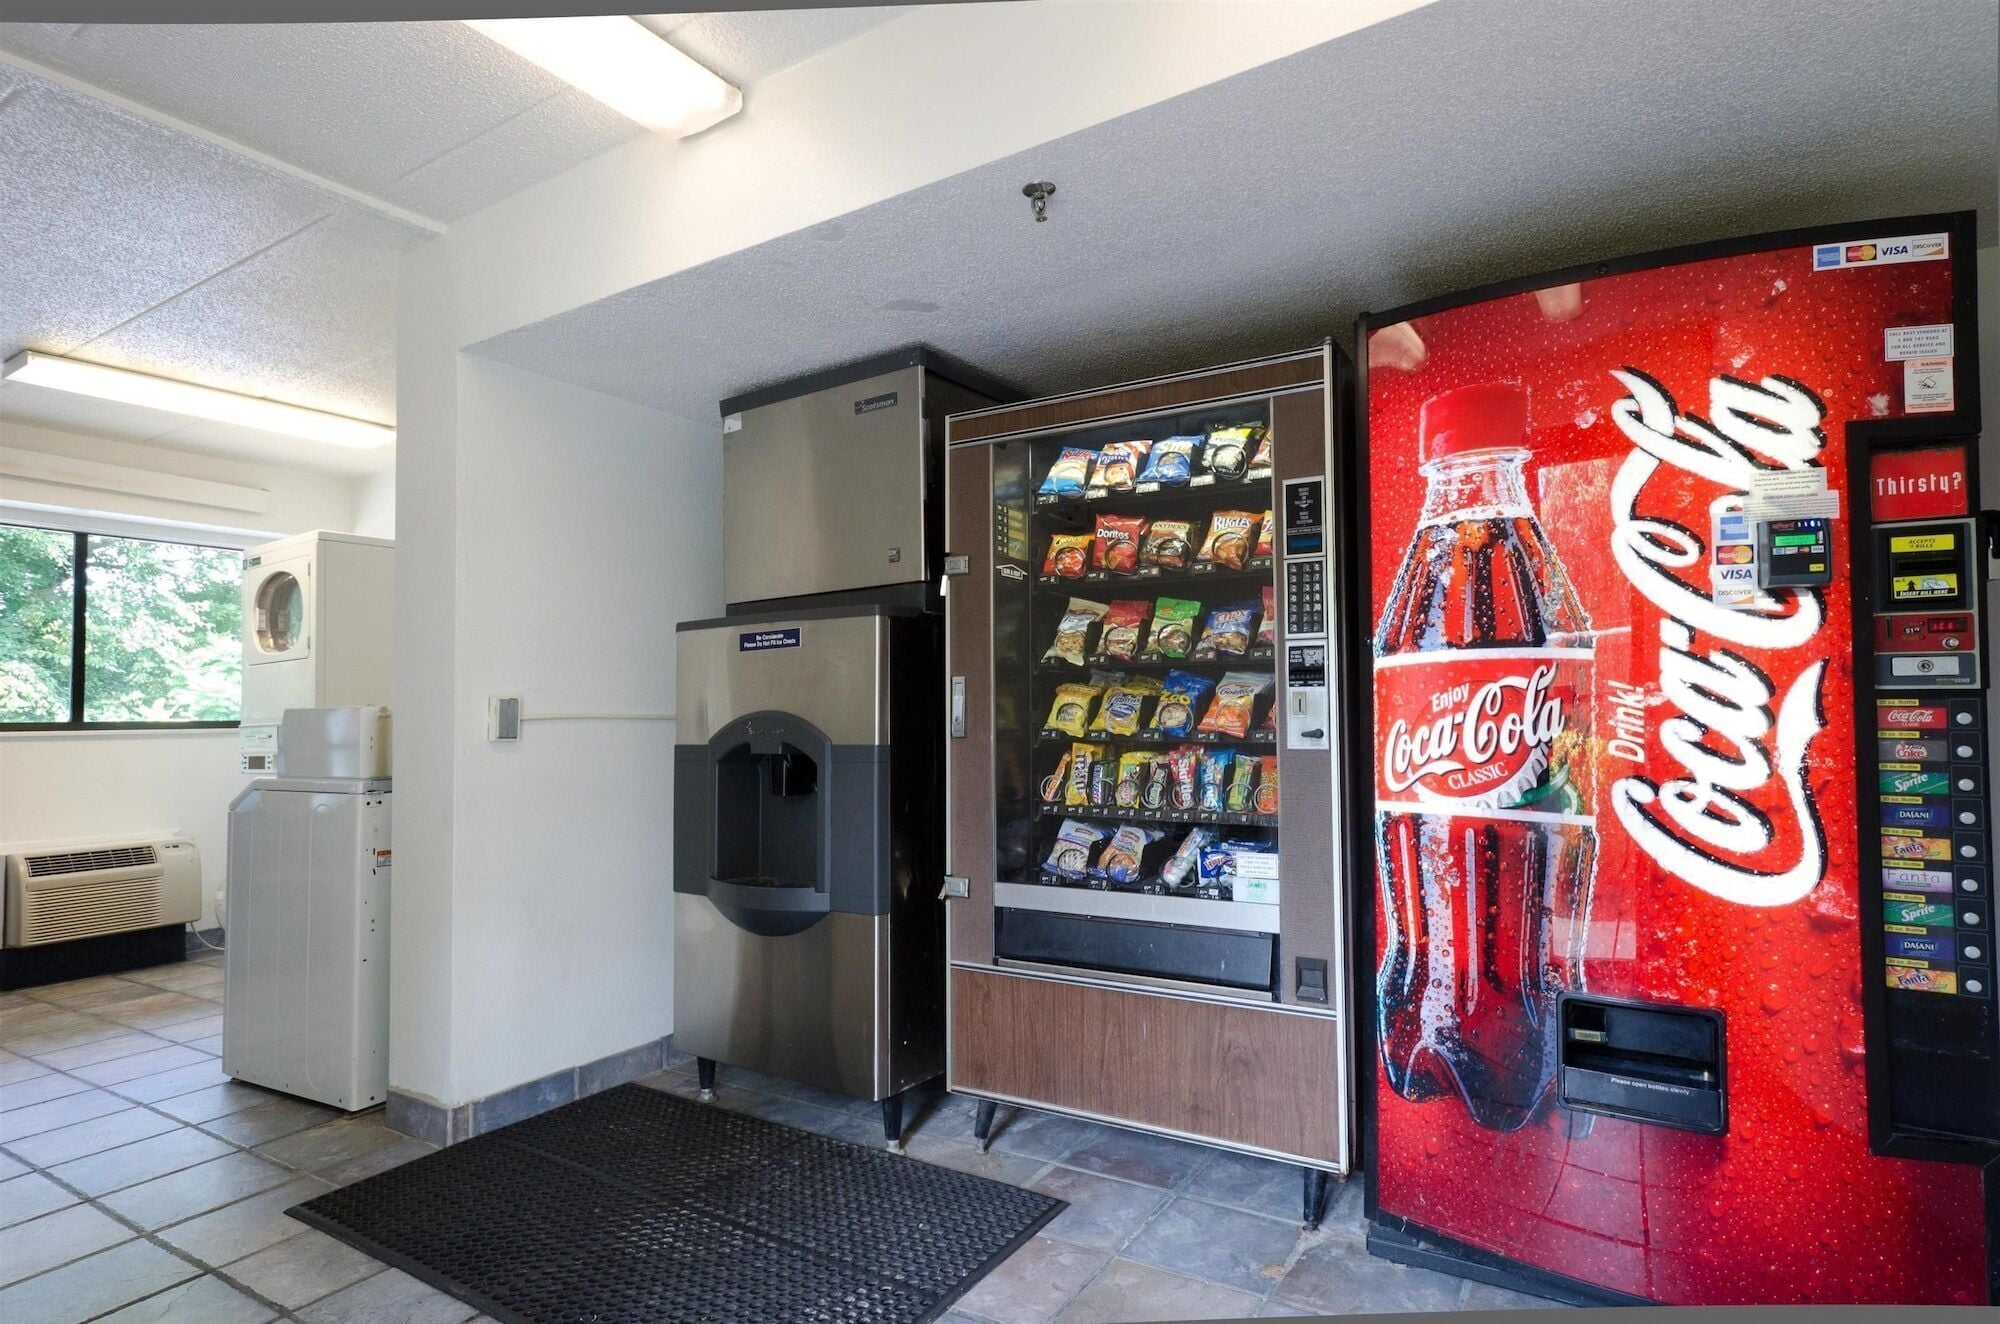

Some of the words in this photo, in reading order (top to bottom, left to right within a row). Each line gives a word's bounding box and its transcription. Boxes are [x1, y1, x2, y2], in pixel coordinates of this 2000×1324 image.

[1881, 245, 1908, 256] VISA
[862, 399, 895, 412] Scotsman
[1876, 471, 1962, 496] Thirsty?
[1214, 516, 1250, 530] BUGLES
[1097, 528, 1130, 540] Doritos
[1720, 569, 1752, 580] VISA
[1430, 683, 1470, 712] Enjoy
[1607, 680, 1646, 764] Drink!
[1888, 710, 1935, 722] Coca-Cola
[1384, 662, 1566, 792] Coca-Cola
[1896, 748, 1925, 758] Coke
[1178, 758, 1194, 808] Skittles
[1448, 762, 1508, 790] CLASSIC
[1894, 773, 1928, 792] Sprite
[1894, 844, 1925, 855] Fanta
[1887, 868, 1940, 883] Fanta
[1901, 905, 1936, 922] Sprite
[1904, 942, 1934, 950] DASANI
[1898, 974, 1930, 985] Fanta
[1611, 1077, 1631, 1086] Please
[1648, 1083, 1669, 1092] bottles
[1670, 1087, 1690, 1096] slowly
